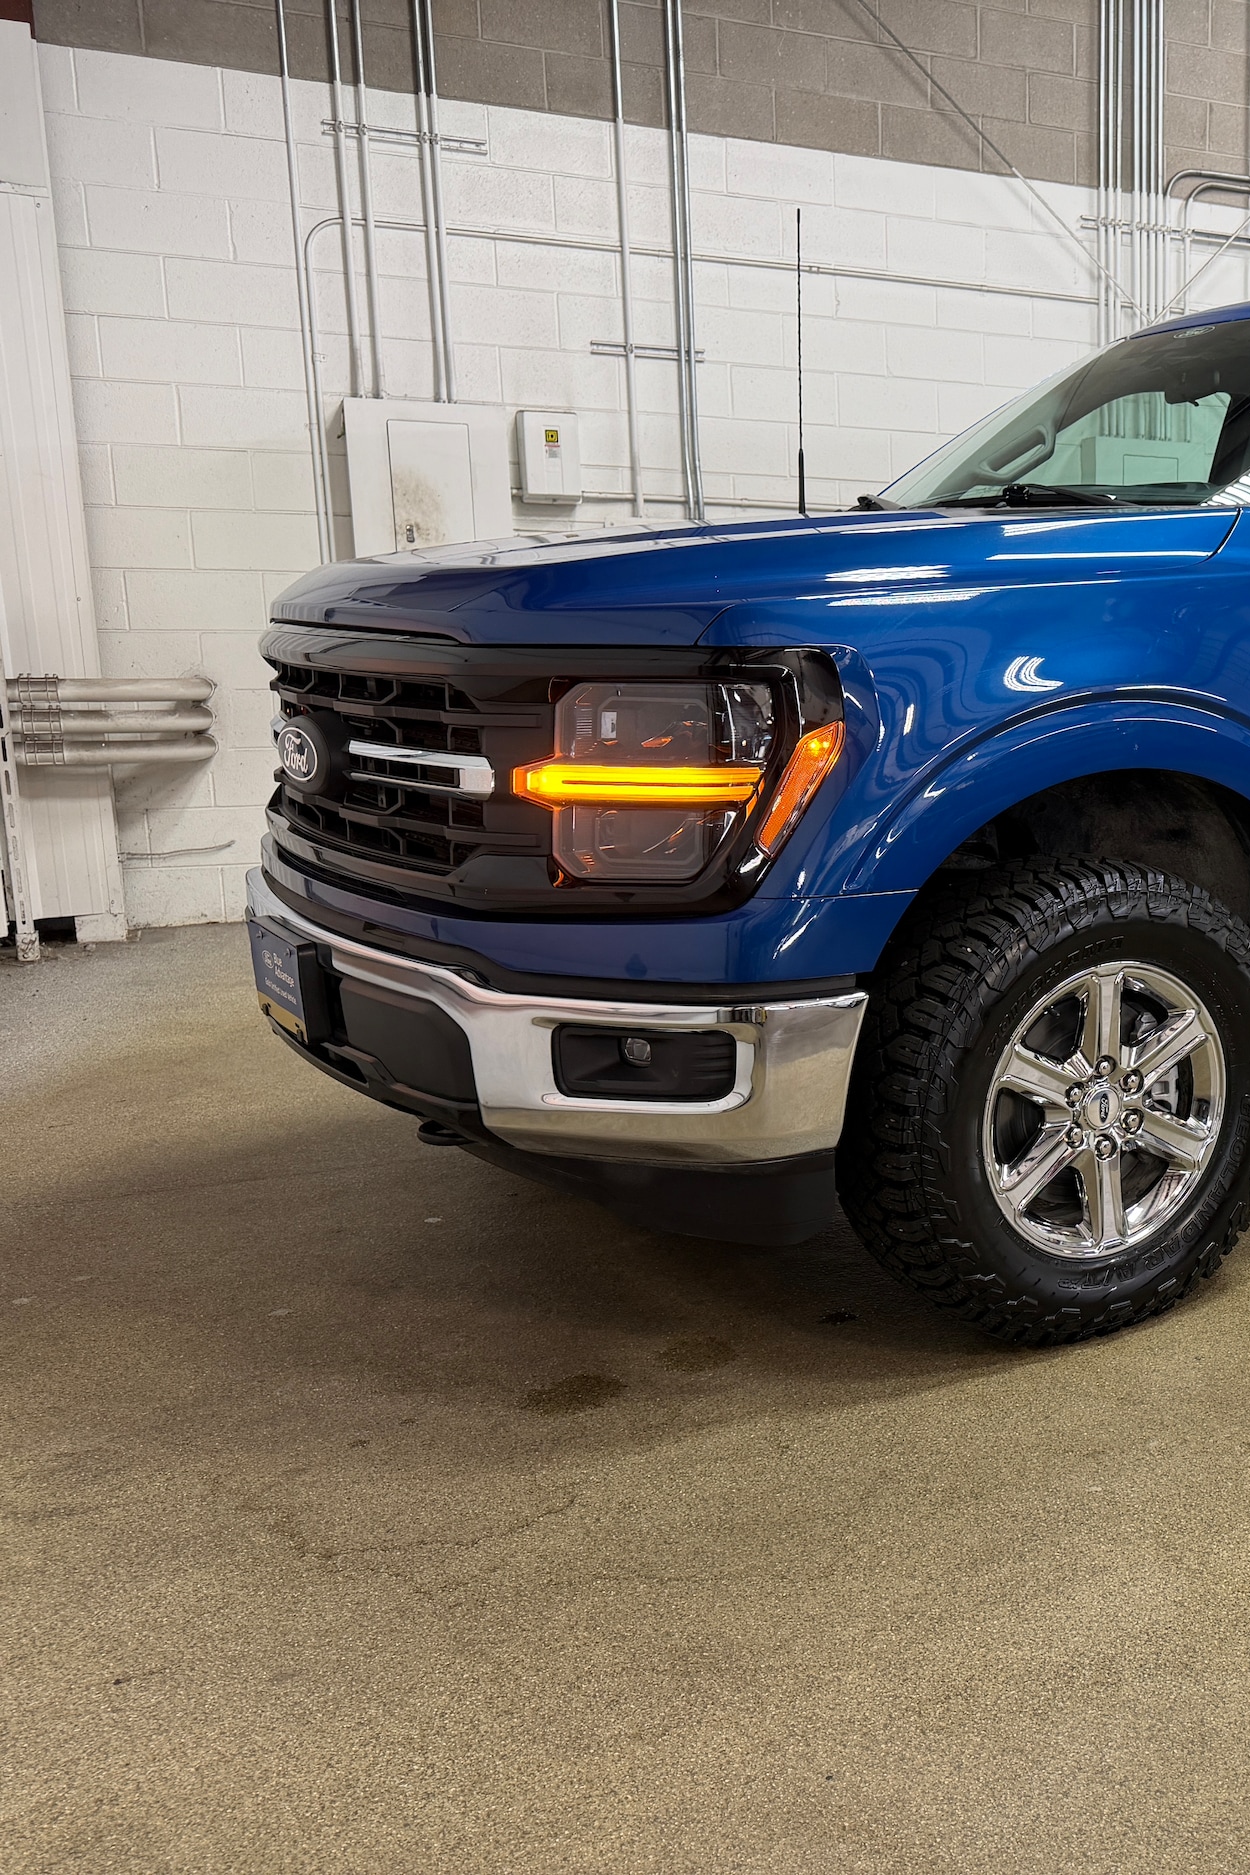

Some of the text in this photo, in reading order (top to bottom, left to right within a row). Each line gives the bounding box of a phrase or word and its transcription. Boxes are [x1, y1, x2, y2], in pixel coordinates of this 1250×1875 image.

[284, 733, 309, 773] Ford
[273, 952, 283, 967] Blue
[984, 934, 1125, 1057] YOKOHAMA
[1100, 1097, 1108, 1118] Ford
[1080, 1260, 1136, 1291] A/T
